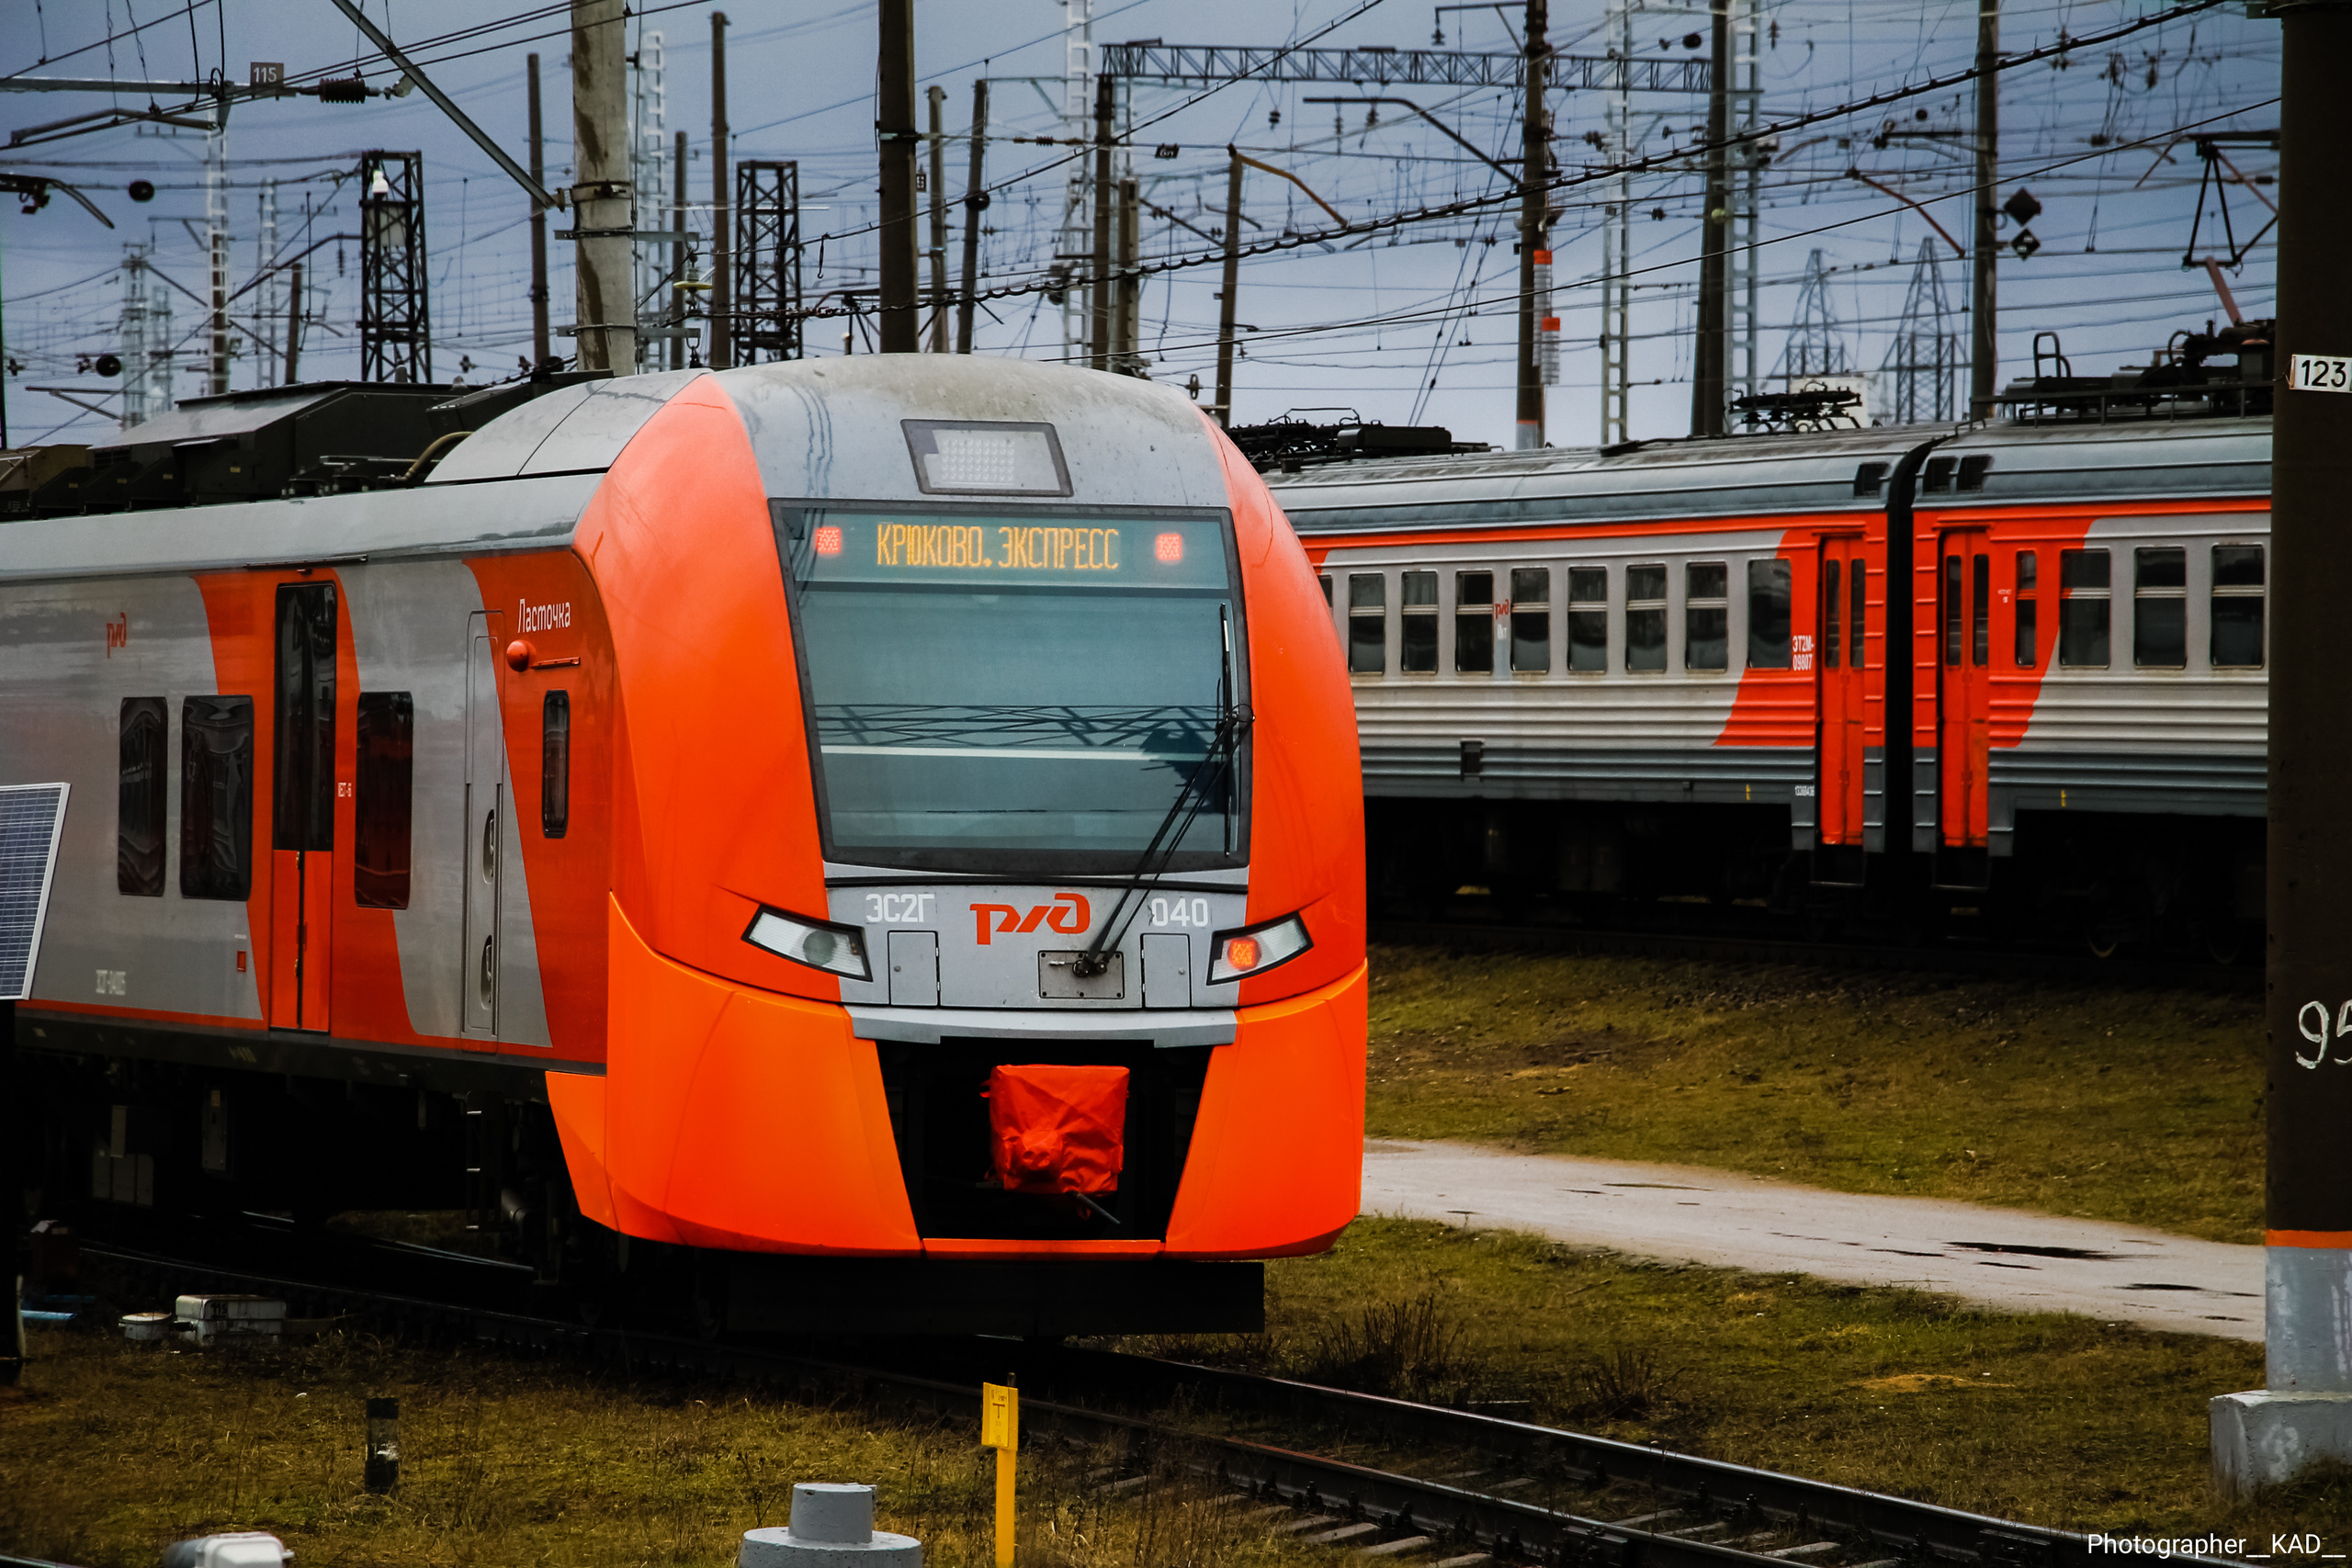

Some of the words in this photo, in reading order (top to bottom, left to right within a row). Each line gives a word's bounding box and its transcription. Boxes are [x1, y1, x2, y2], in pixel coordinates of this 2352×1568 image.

[253, 67, 277, 83] 115
[2301, 359, 2346, 388] 123
[876, 524, 992, 568] КРЮКОВО.
[999, 526, 1119, 570] ЭКСПРЕСС
[517, 598, 571, 633] Ласточка
[865, 893, 934, 923] ЭС2Г
[1149, 897, 1208, 928] 040
[2295, 998, 2352, 1070] 95
